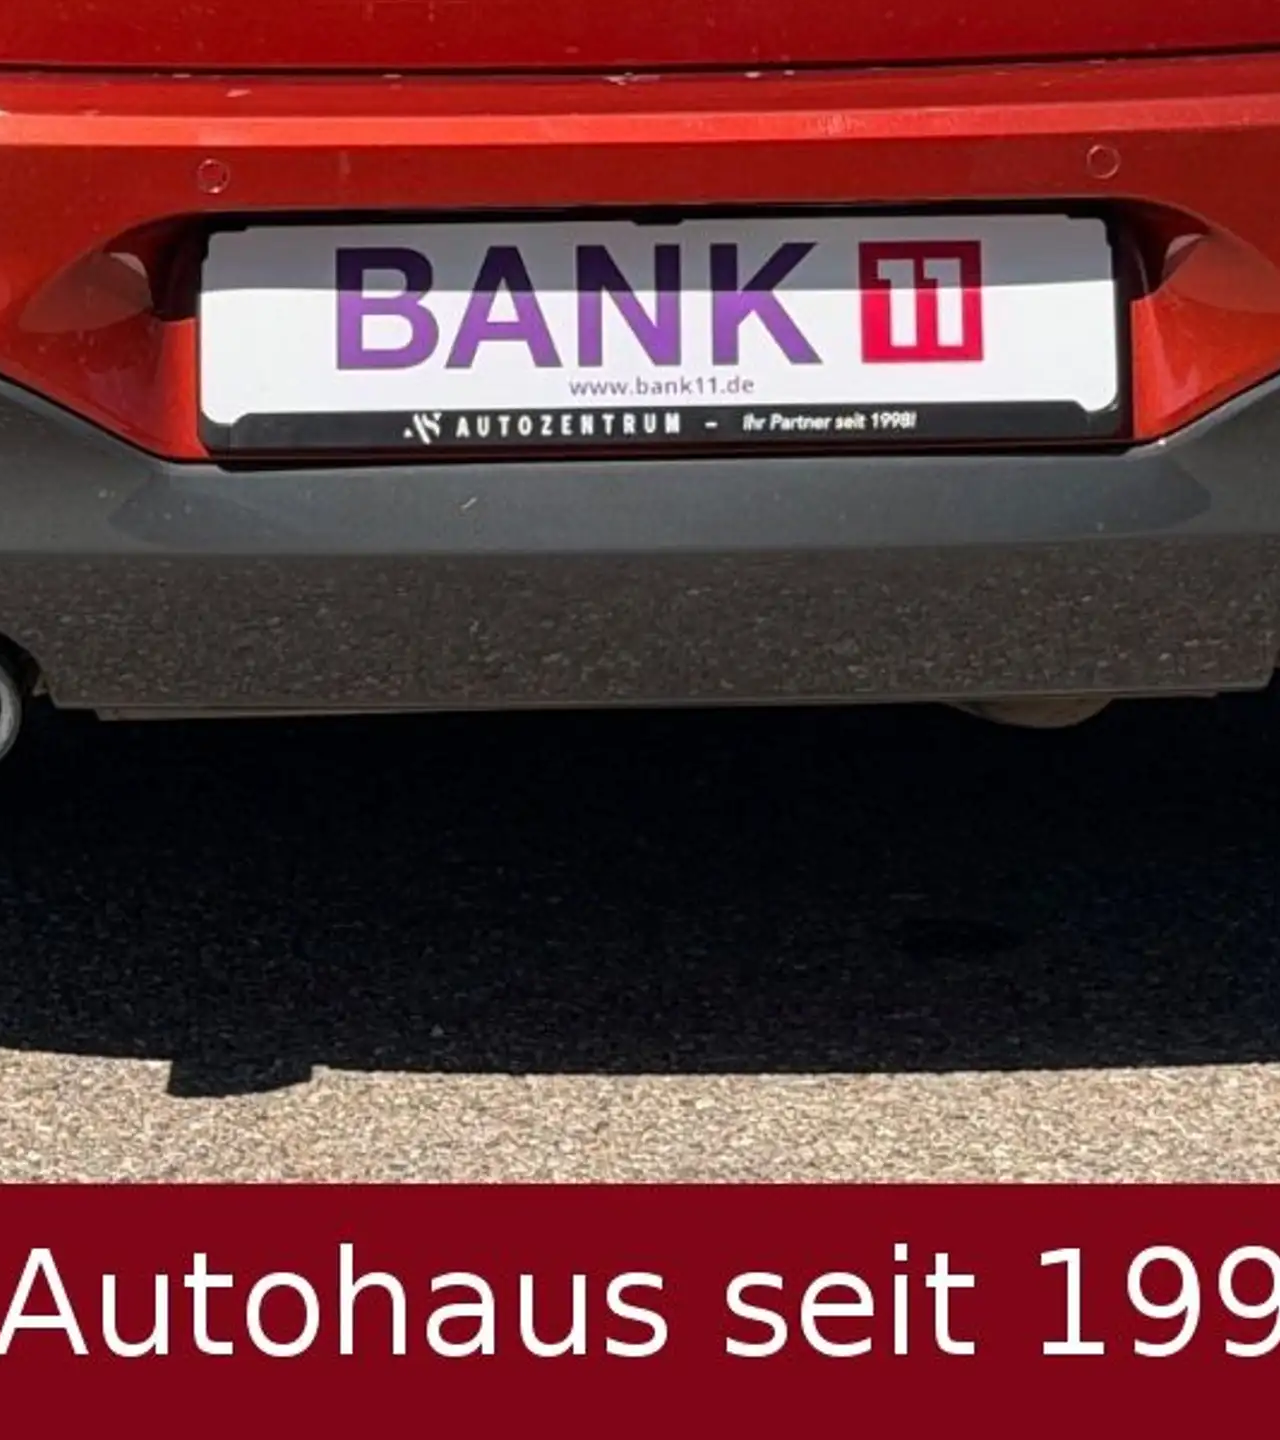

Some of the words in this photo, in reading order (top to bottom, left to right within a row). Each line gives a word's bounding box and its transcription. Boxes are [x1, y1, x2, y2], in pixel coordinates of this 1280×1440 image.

[334, 241, 824, 370] BANK
[876, 257, 965, 348] 11
[569, 374, 755, 397] www.bank11.de
[455, 411, 681, 438] AUTOZENTRUM
[742, 412, 766, 431] Ihr
[770, 412, 832, 431] Partner
[834, 411, 865, 430] seit
